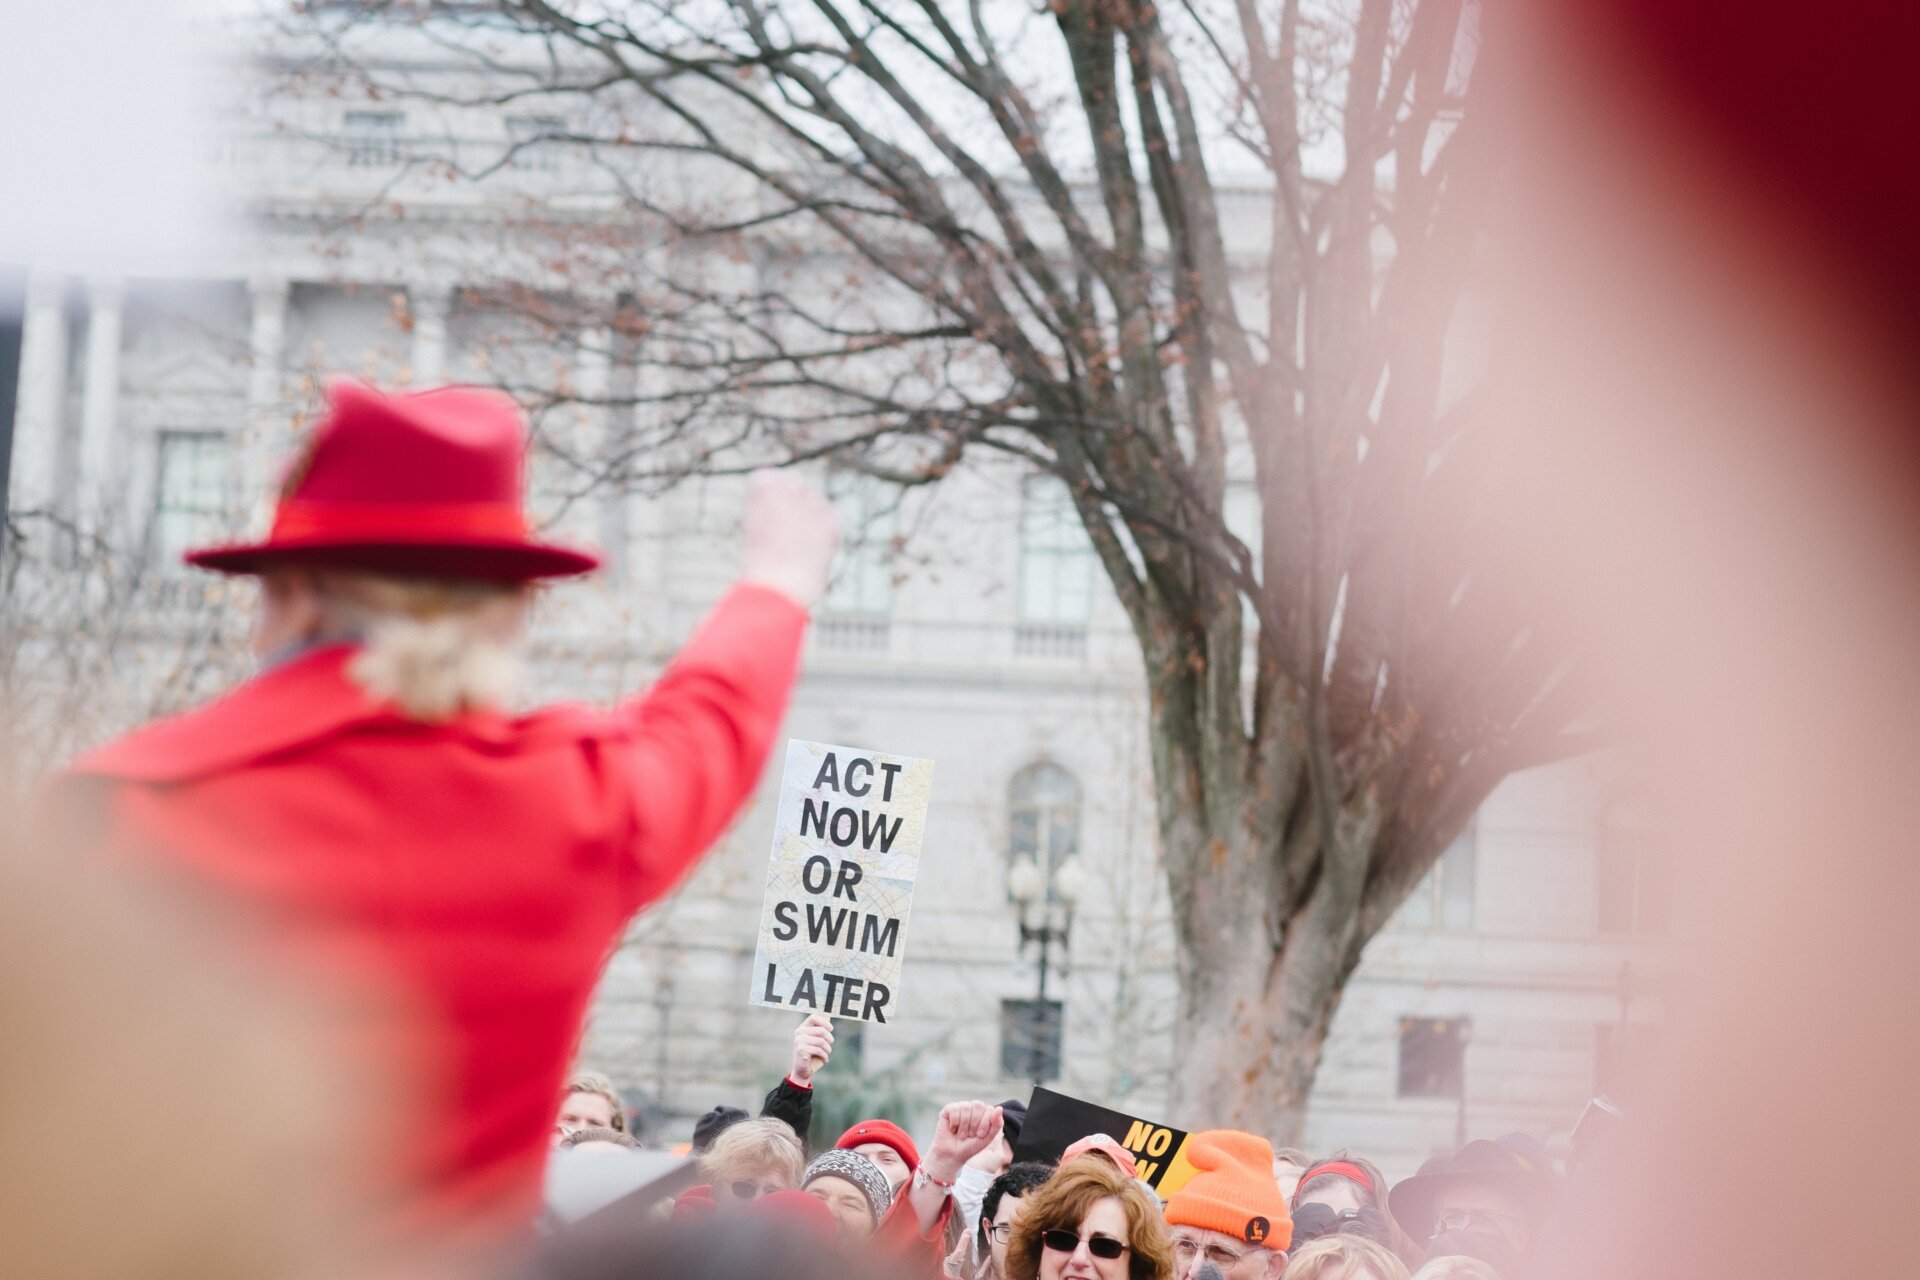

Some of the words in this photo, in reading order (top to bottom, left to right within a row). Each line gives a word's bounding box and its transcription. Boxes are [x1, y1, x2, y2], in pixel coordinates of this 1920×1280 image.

[812, 752, 902, 802] ACT
[800, 798, 903, 854] NOW
[802, 854, 863, 902] OR
[772, 901, 900, 958] SWIM
[764, 963, 890, 1024] LATER
[1121, 1120, 1173, 1157] NO
